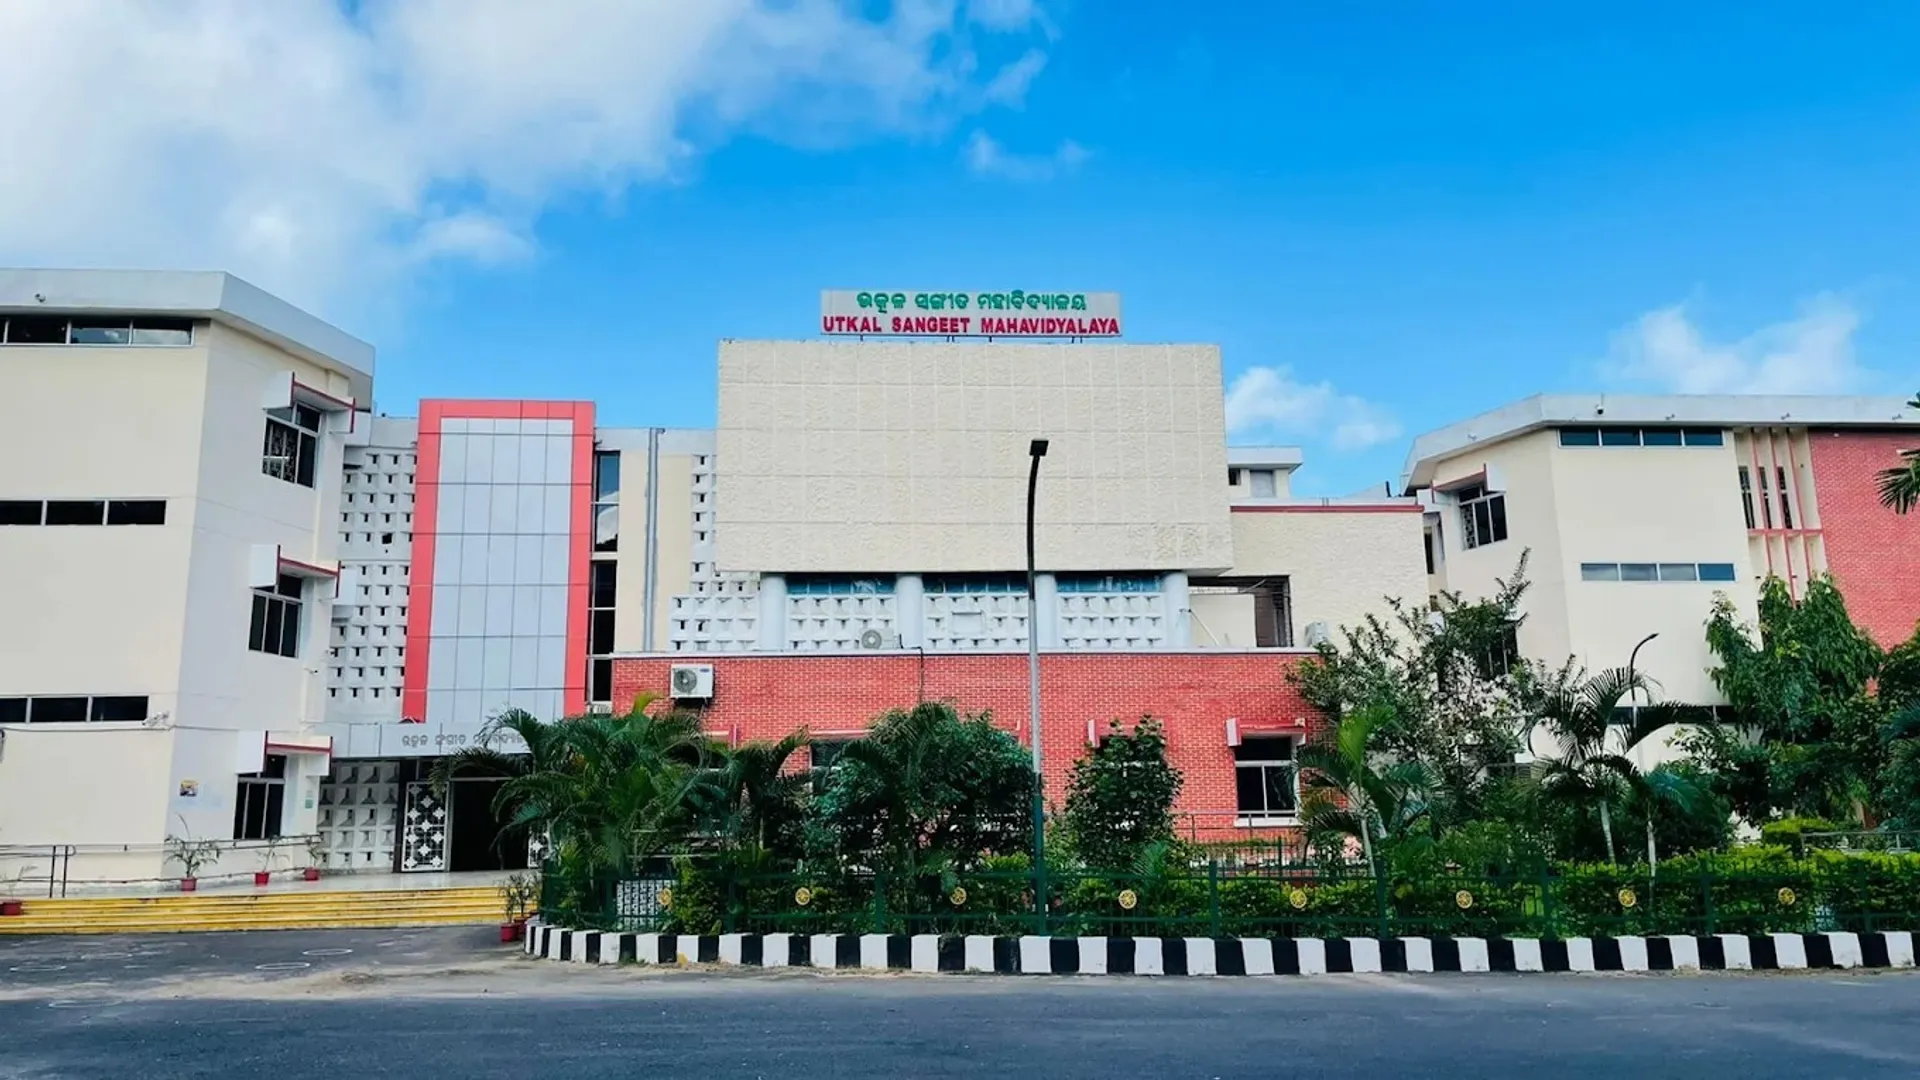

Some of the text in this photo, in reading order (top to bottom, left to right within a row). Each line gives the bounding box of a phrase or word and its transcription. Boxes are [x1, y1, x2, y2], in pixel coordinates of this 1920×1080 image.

[823, 316, 1120, 334] UTKAL SANGEET MAHAVIDYALAYA
